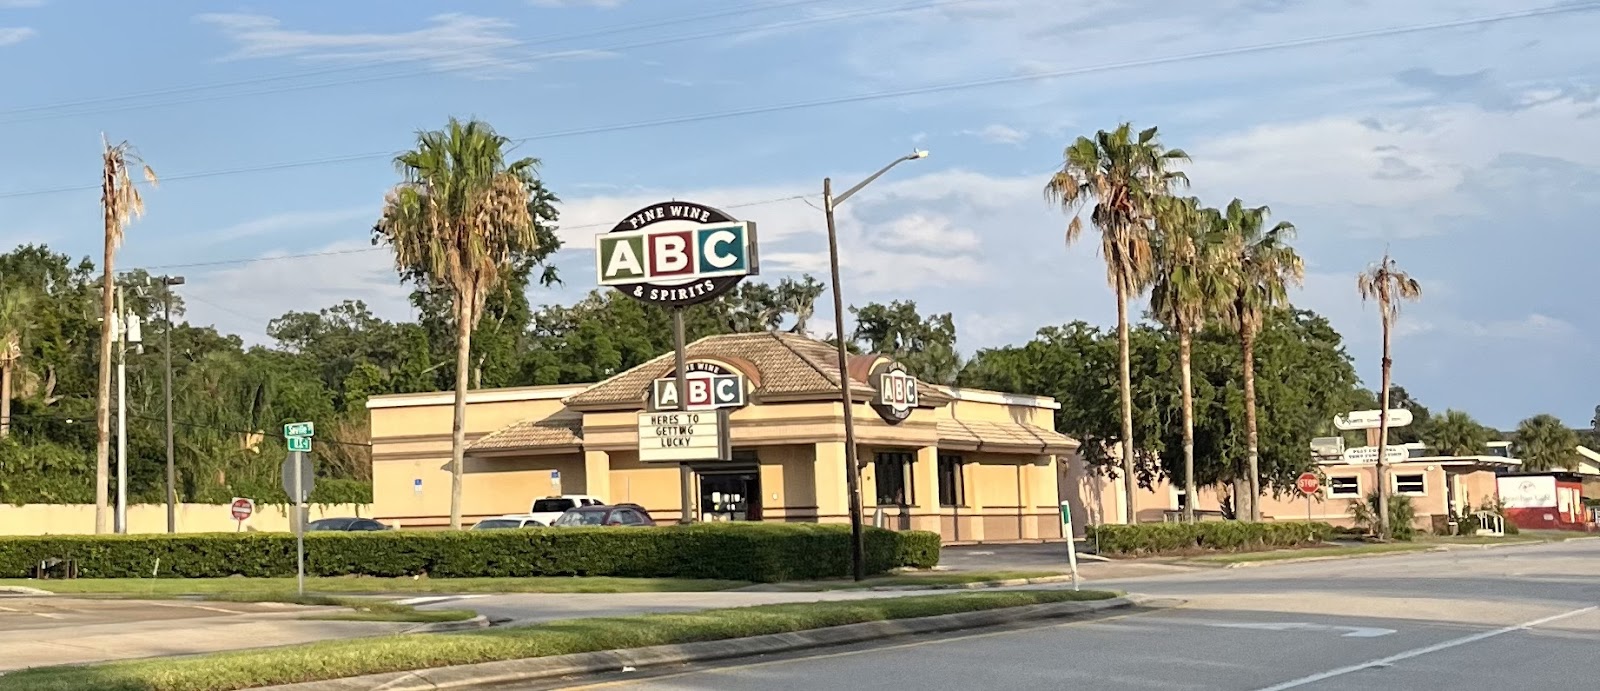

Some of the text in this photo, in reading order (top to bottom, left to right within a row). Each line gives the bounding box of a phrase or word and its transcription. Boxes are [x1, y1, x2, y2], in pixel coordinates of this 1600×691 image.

[670, 206, 710, 222] WINE
[605, 231, 738, 277] ABC
[633, 280, 714, 301] & SPIRITS
[697, 363, 719, 374] WINE
[661, 379, 735, 405] ABC
[884, 377, 914, 402] ABC
[651, 414, 699, 425] HERES TO
[661, 437, 691, 447] LUCKY
[1299, 478, 1317, 488] STOP
